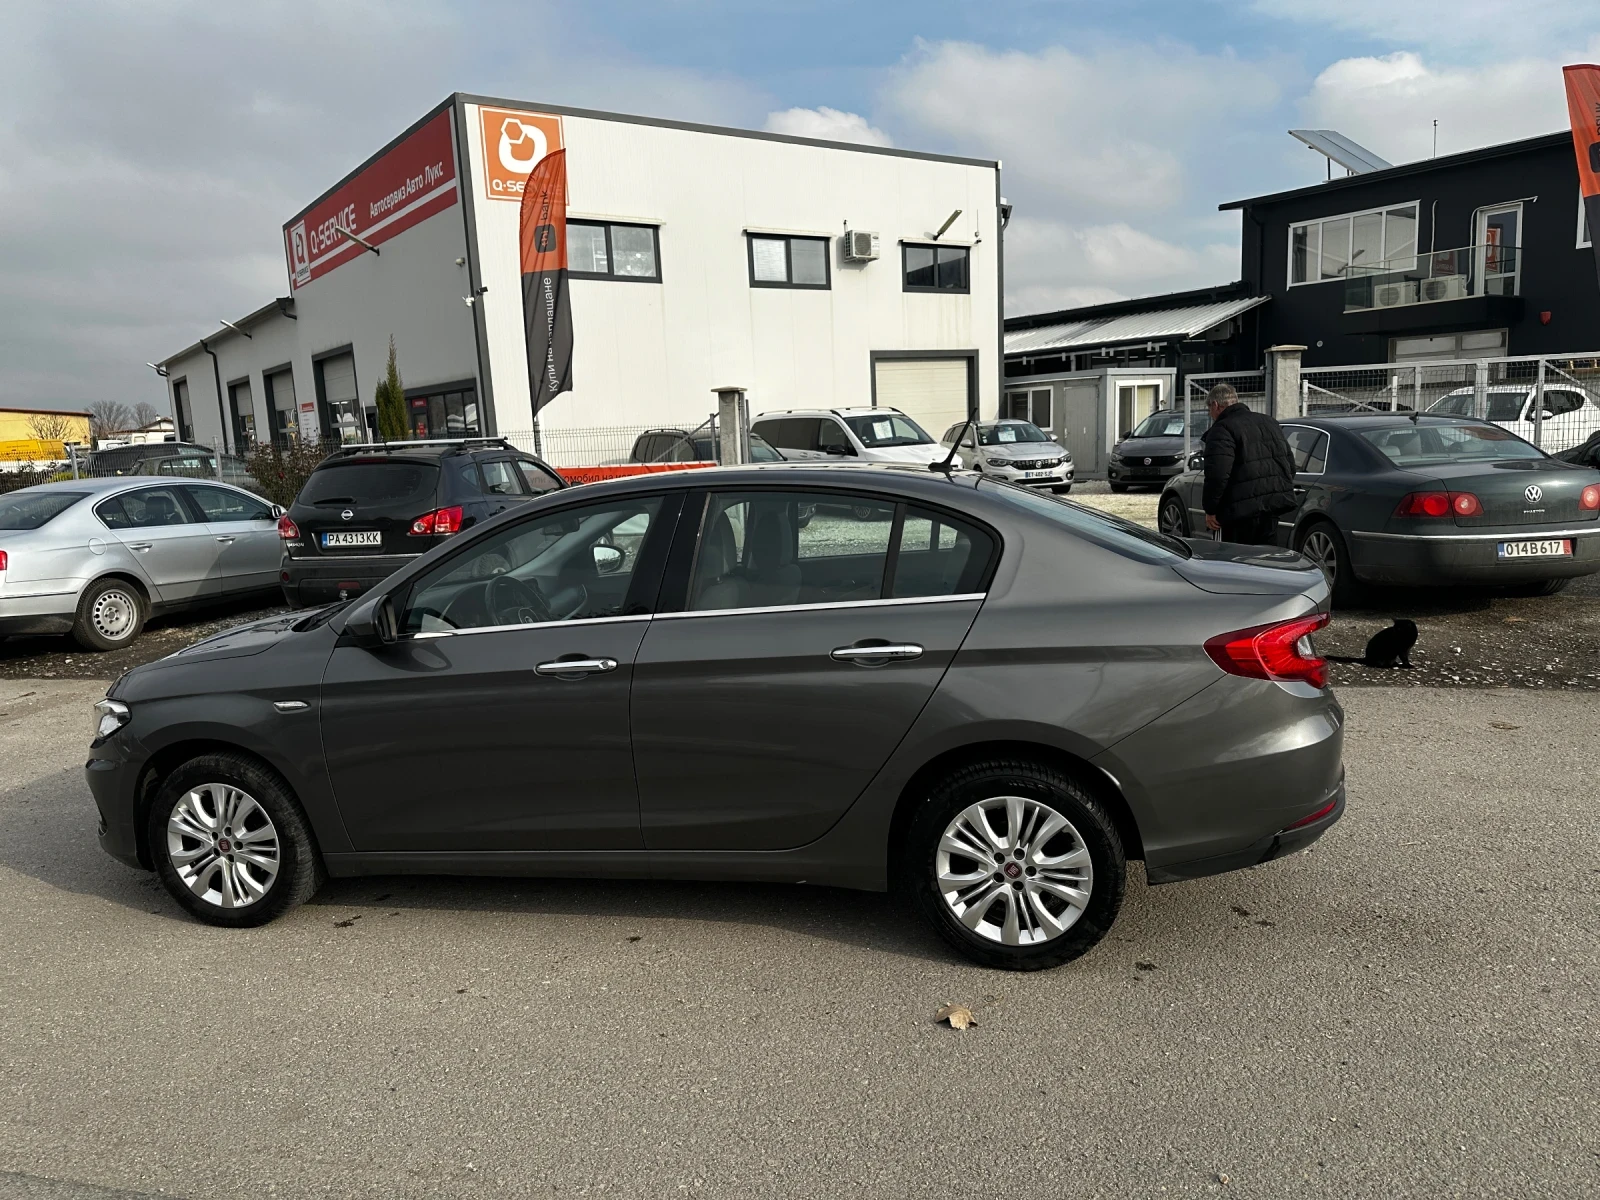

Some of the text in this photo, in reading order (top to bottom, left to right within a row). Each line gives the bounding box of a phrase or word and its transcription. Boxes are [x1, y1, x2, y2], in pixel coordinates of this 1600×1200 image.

[370, 161, 444, 219] Автосервиз Авто Лукс
[539, 190, 549, 221] bank
[547, 347, 554, 362] на
[547, 364, 560, 392] Купи
[328, 532, 379, 545] PA 4313 KK
